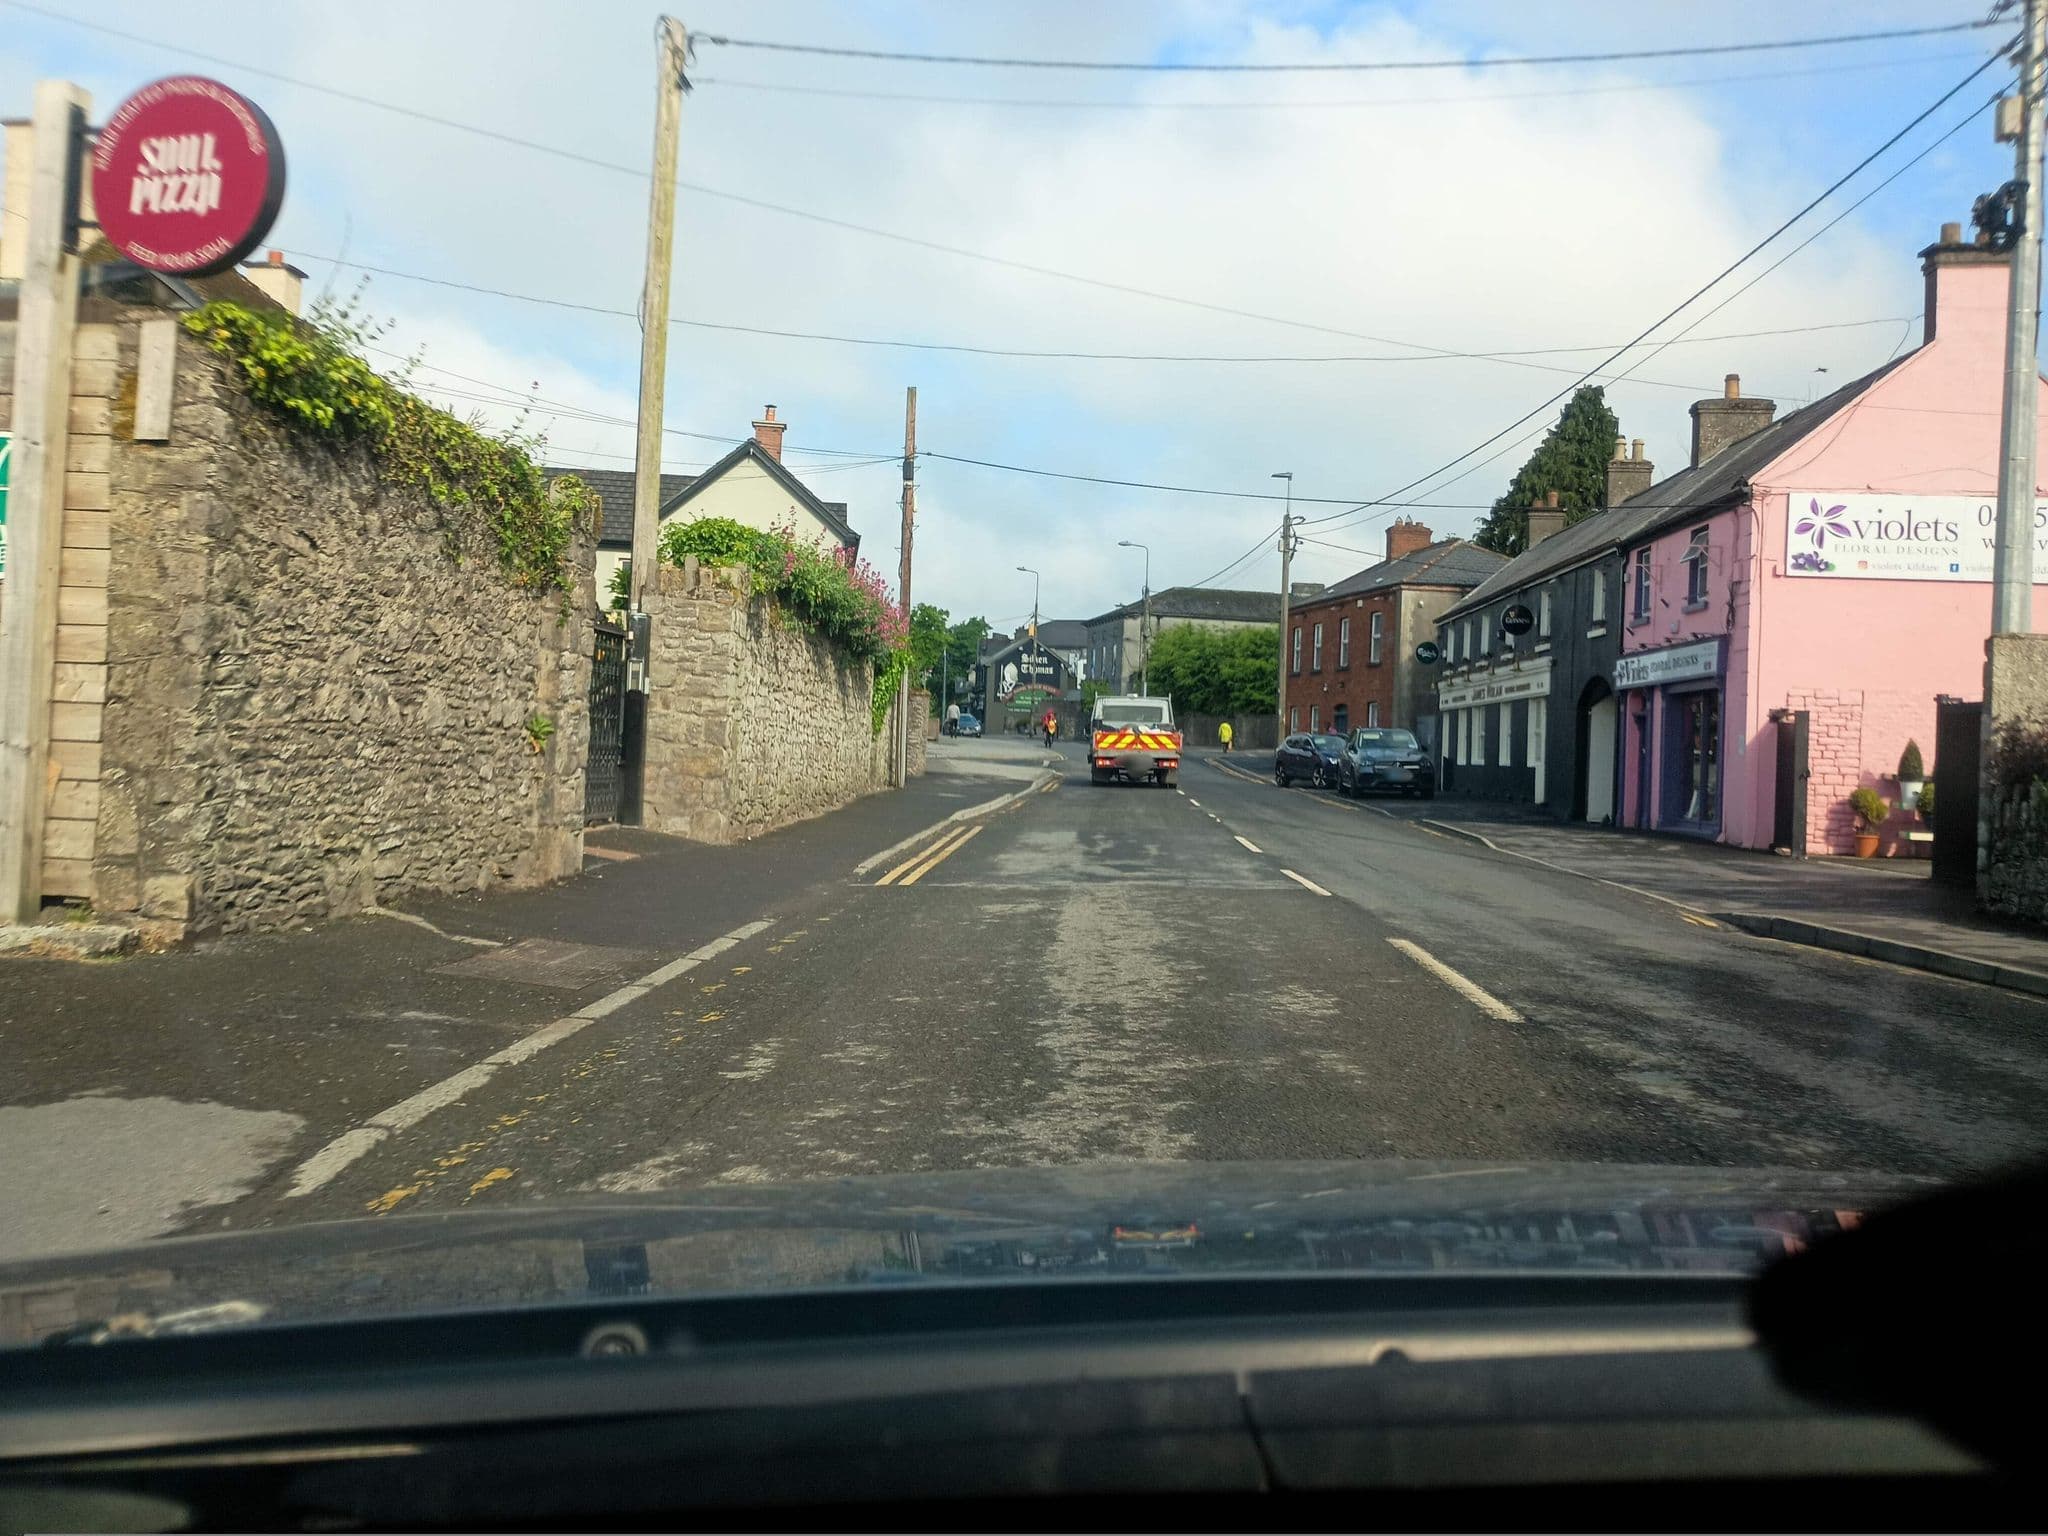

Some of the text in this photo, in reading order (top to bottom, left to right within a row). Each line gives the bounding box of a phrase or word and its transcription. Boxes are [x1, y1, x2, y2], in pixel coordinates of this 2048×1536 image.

[129, 172, 222, 216] PIZZA
[1852, 508, 1959, 543] violets
[1834, 543, 1959, 556] FLORAL DESIGNS
